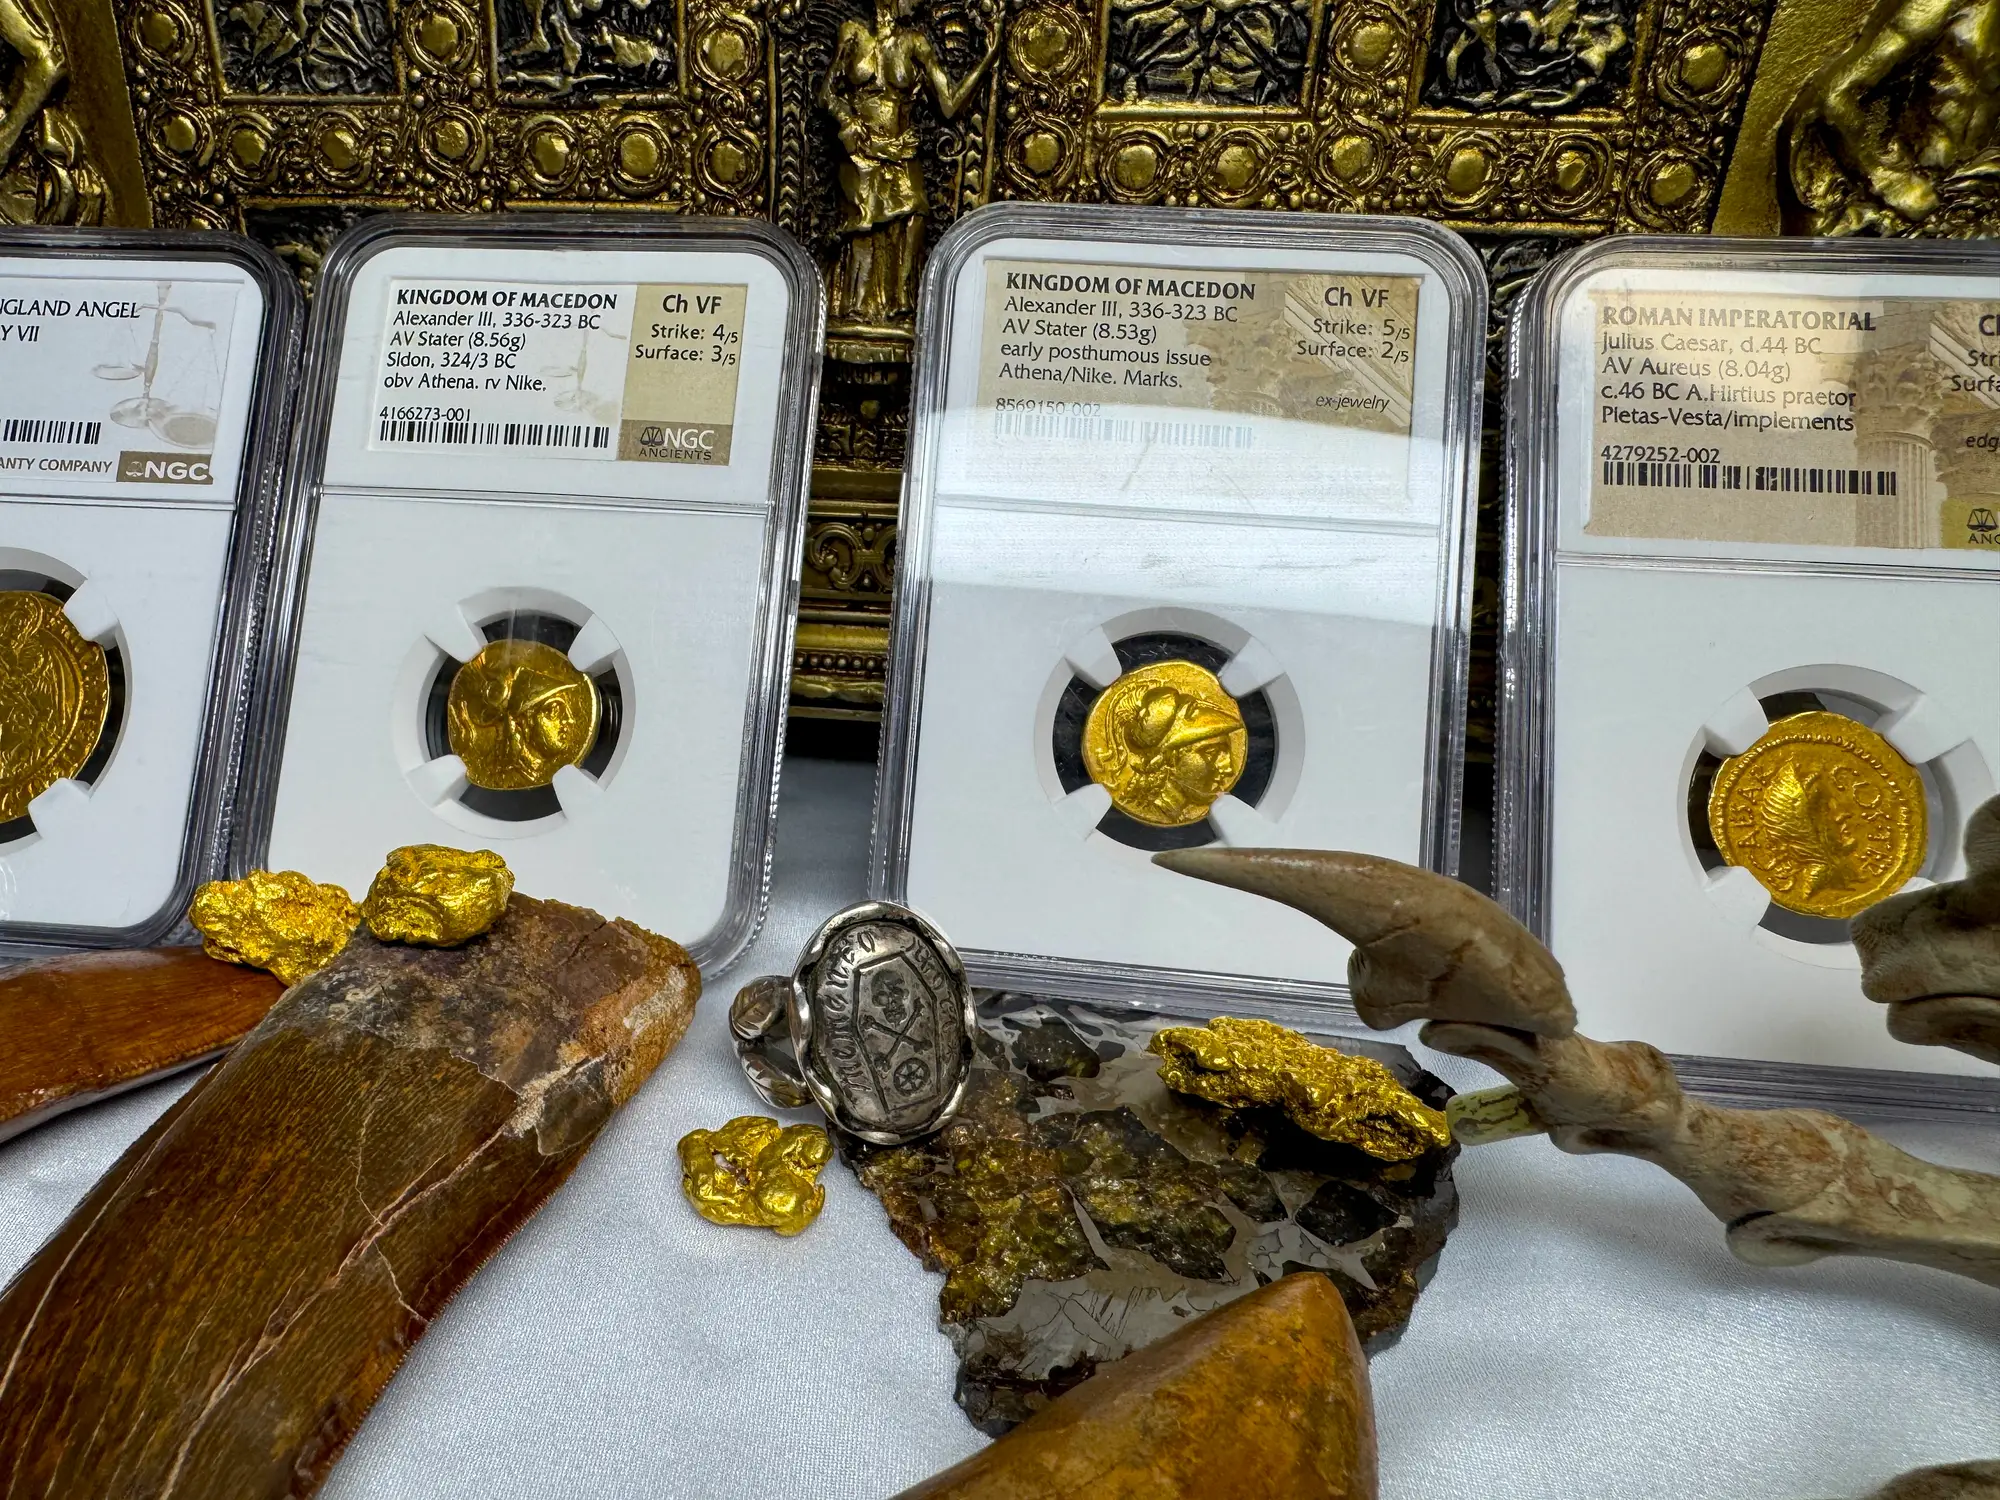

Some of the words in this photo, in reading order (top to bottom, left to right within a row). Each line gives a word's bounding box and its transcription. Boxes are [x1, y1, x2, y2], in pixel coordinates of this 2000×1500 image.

[1006, 272, 1110, 294] KINGDOM
[1115, 277, 1142, 295] OF
[1146, 280, 1256, 300] MACEDON
[397, 289, 487, 306] KINGDOM
[492, 291, 517, 306] OF
[520, 292, 617, 309] MACEDON
[662, 294, 688, 313] Ch
[696, 295, 722, 314] VF
[1324, 287, 1353, 307] Ch
[1361, 288, 1390, 308] VF
[76, 301, 141, 318] ANGEL
[393, 310, 474, 326] Alexander
[478, 311, 496, 328] III,
[503, 312, 571, 329] 336-323
[578, 314, 601, 329] BC
[1004, 296, 1096, 315] Alexander
[1101, 301, 1122, 319] III,
[1129, 301, 1206, 320] 336-323
[1214, 306, 1238, 322] BC
[1602, 306, 1693, 326] ROMAN
[1699, 308, 1876, 331] IMPERATORIAL
[18, 325, 40, 341] VII
[651, 323, 705, 340] Strike:
[712, 324, 738, 345] 4/5
[1002, 318, 1030, 335] AV
[1034, 320, 1087, 337] Stater
[1093, 323, 1157, 346] (8.53g)
[1313, 318, 1373, 336] Strike:
[1383, 319, 1411, 341] 5/5
[1979, 314, 2000, 336] C
[390, 331, 415, 346] AV
[418, 331, 464, 347] Stater
[468, 332, 526, 352] (8.56g)
[1297, 340, 1373, 358] Surface:
[1381, 341, 1409, 364] 2/5
[1601, 332, 1655, 355] Julius
[1660, 332, 1733, 354] Caesar,
[1740, 336, 1788, 353] d.44
[1795, 337, 1821, 354] BC
[386, 351, 434, 369] Sidon,
[440, 352, 488, 370] 324/3
[494, 353, 516, 369] BC
[635, 344, 703, 360] Surface:
[711, 345, 736, 366] 3/5
[1000, 342, 1044, 361] early
[1049, 345, 1159, 364] posthumous
[1166, 350, 1211, 366] issue
[999, 363, 1116, 385] Athena/Nike.
[1123, 369, 1183, 388] Marks.
[1602, 356, 1635, 375] AV
[1639, 357, 1711, 377] Aureus
[1719, 360, 1790, 383] (8.04g)
[384, 373, 414, 389] obv
[418, 373, 479, 389] Athena.
[485, 377, 501, 390] rv
[1316, 394, 1390, 413] ex-jewelry
[1601, 381, 1645, 399] c.46
[1652, 382, 1680, 400] BC
[1783, 390, 1857, 409] praetor
[379, 406, 471, 422] 4166273-001
[995, 397, 1101, 417] 8569150-002
[1602, 405, 1854, 432] Pietas-Vesta/implements
[664, 428, 715, 449] NGC
[638, 447, 712, 460] ANCIENTS
[1600, 445, 1720, 464] 4279252-002
[39, 459, 112, 473] COMPANY
[144, 461, 209, 480] NGC
